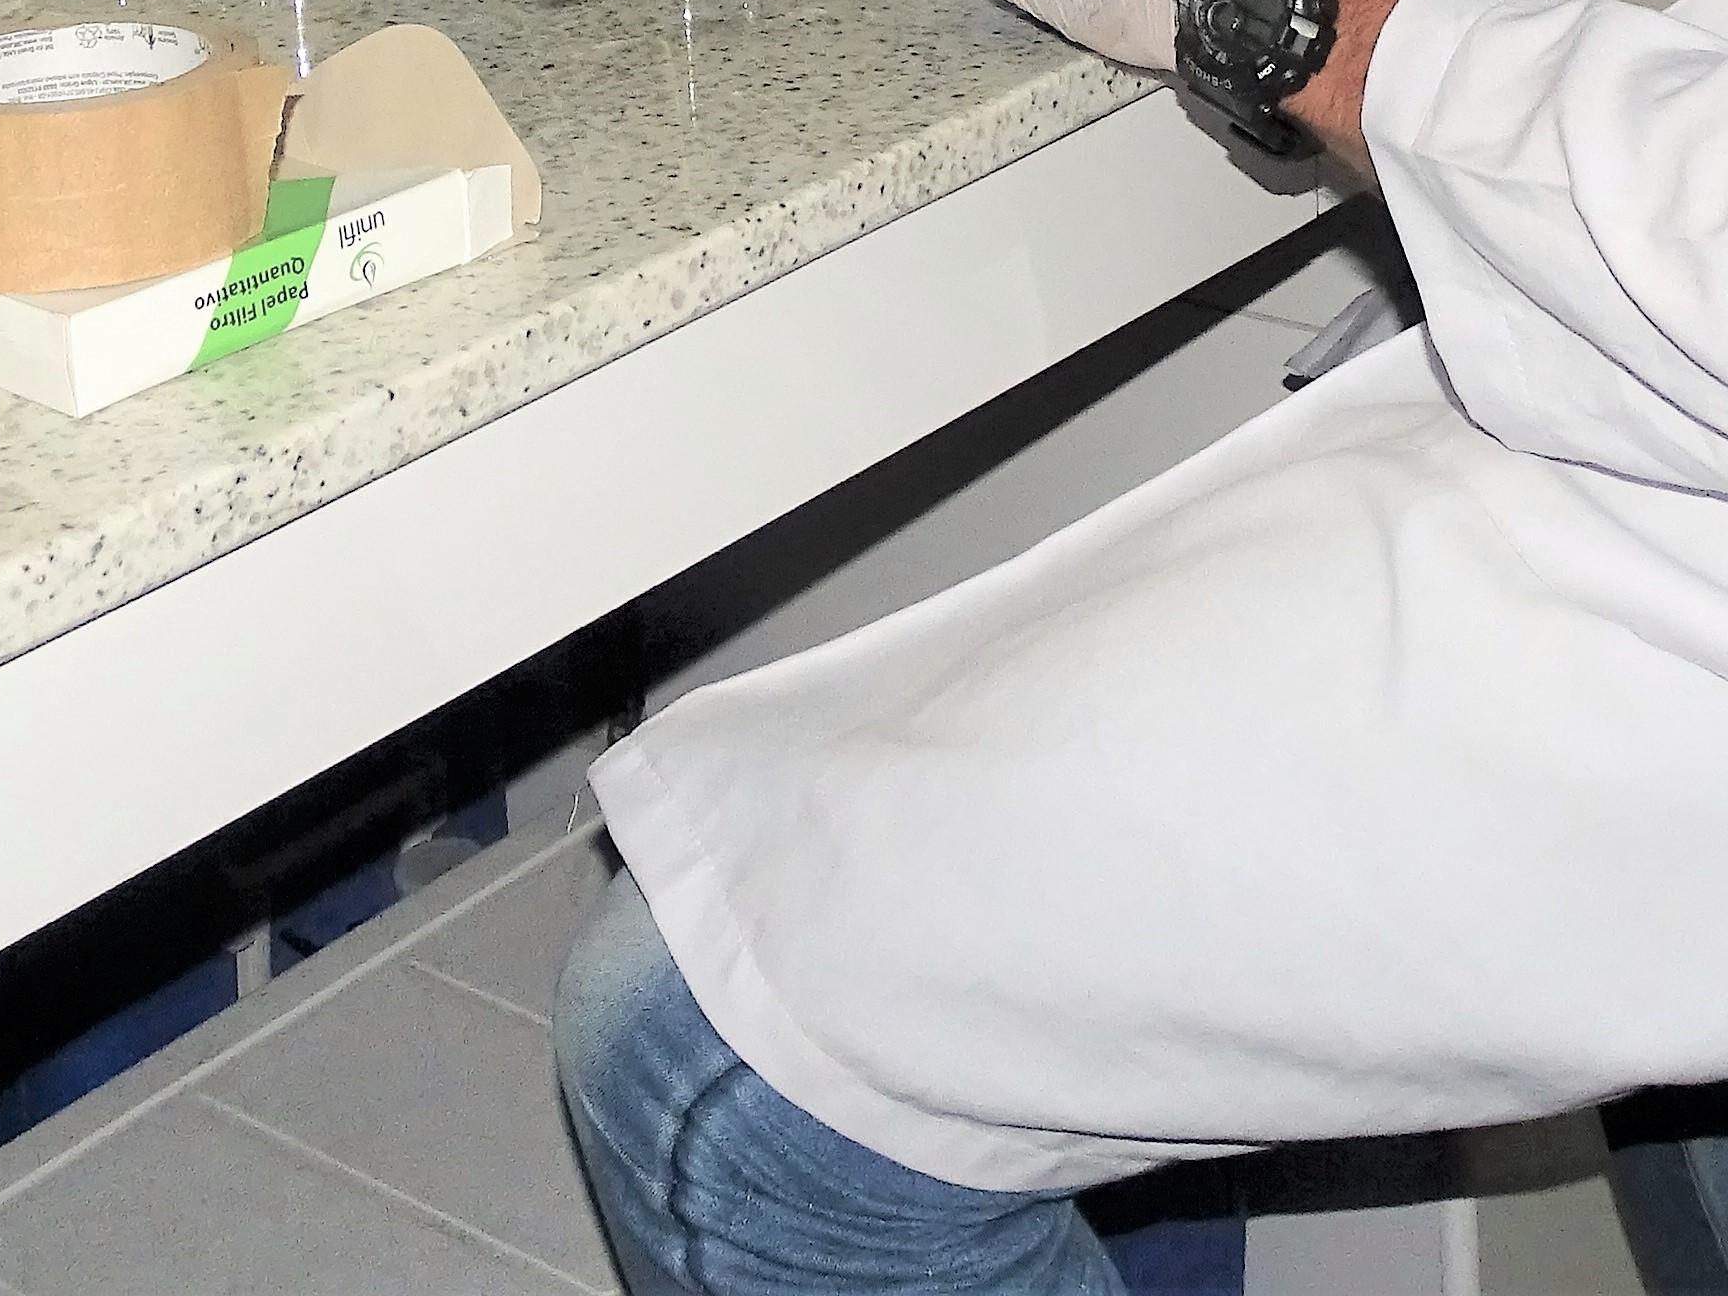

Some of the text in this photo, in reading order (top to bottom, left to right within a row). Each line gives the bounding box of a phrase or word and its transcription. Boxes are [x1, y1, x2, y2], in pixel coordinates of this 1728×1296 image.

[338, 210, 386, 249] unifil
[194, 256, 306, 311] Quantitativo
[209, 279, 310, 331] Papel Filtro
